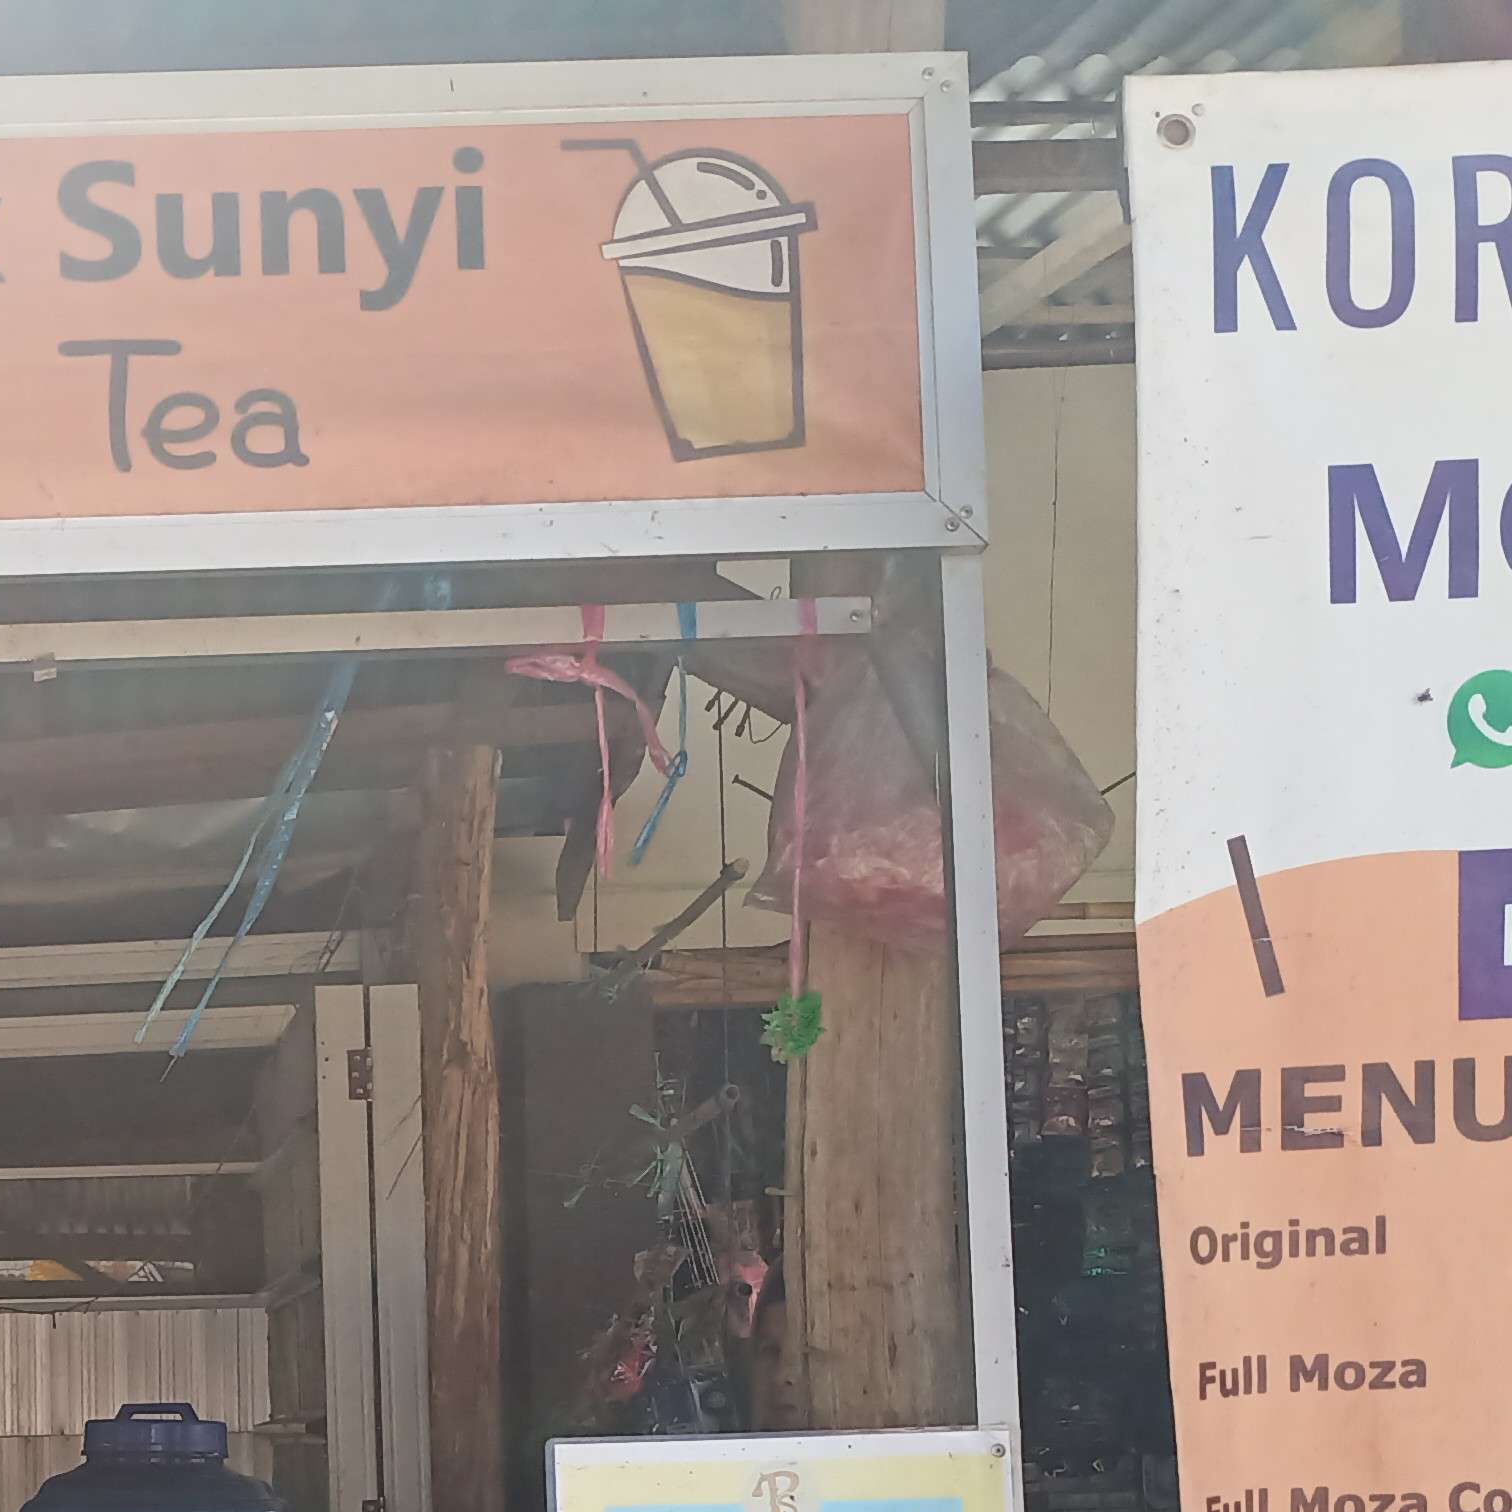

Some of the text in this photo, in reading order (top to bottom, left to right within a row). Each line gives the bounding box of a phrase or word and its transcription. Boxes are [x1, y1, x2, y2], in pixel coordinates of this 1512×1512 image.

[57, 145, 486, 312] Sunyi
[1210, 154, 1512, 333] KOR
[57, 339, 310, 473] Tea
[1327, 458, 1512, 603] M
[1181, 1056, 1512, 1157] MENU
[1189, 1215, 1387, 1270] Original
[1198, 1354, 1427, 1400] Full Moza
